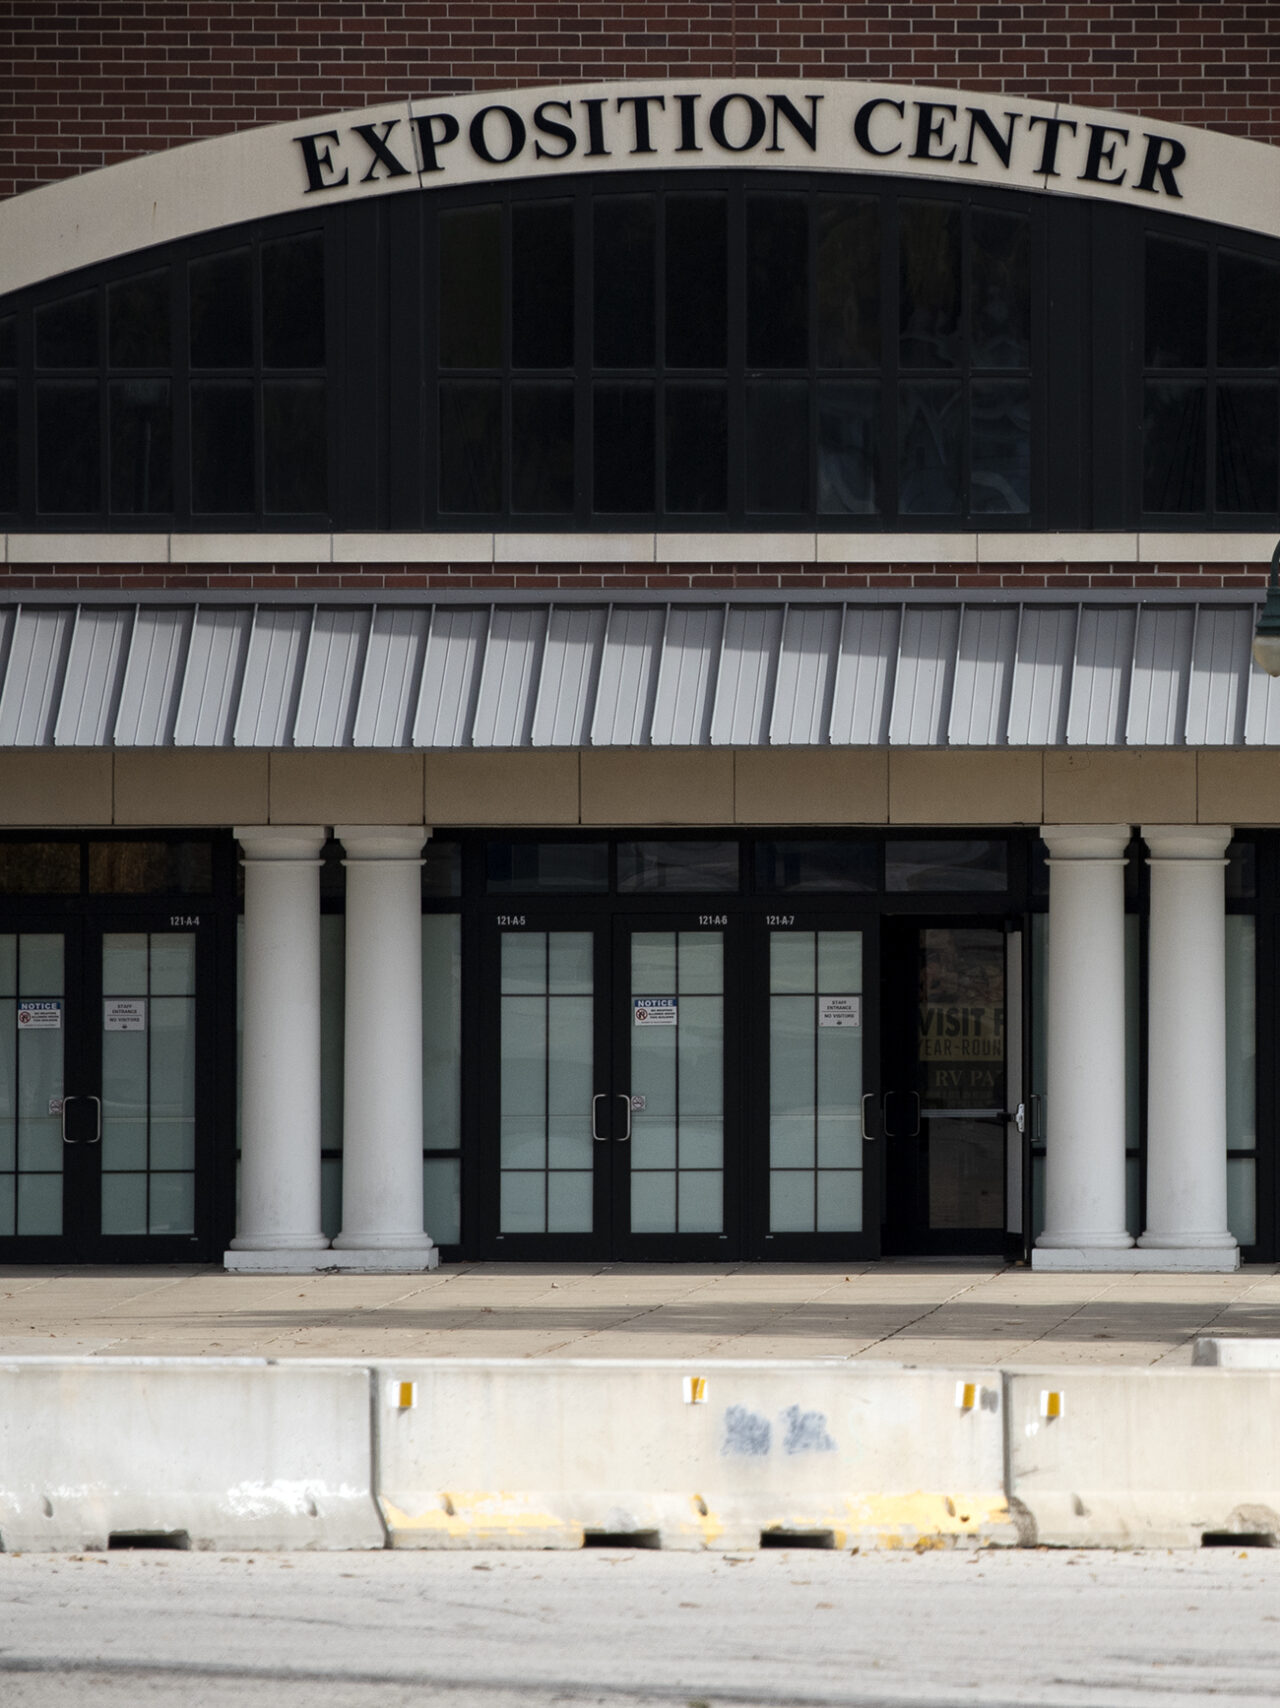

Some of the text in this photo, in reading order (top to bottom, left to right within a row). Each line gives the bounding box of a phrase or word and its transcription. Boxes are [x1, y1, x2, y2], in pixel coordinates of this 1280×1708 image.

[292, 93, 1187, 198] EXPOSITION CENTER
[170, 916, 200, 926] 121-A-4
[496, 915, 526, 926] 121-A-5
[698, 915, 728, 925] 121-A-6
[766, 915, 795, 925] 121-A-7
[21, 1002, 57, 1010] NOTICE
[919, 1007, 985, 1037] VISIT
[934, 1070, 963, 1087] RV
